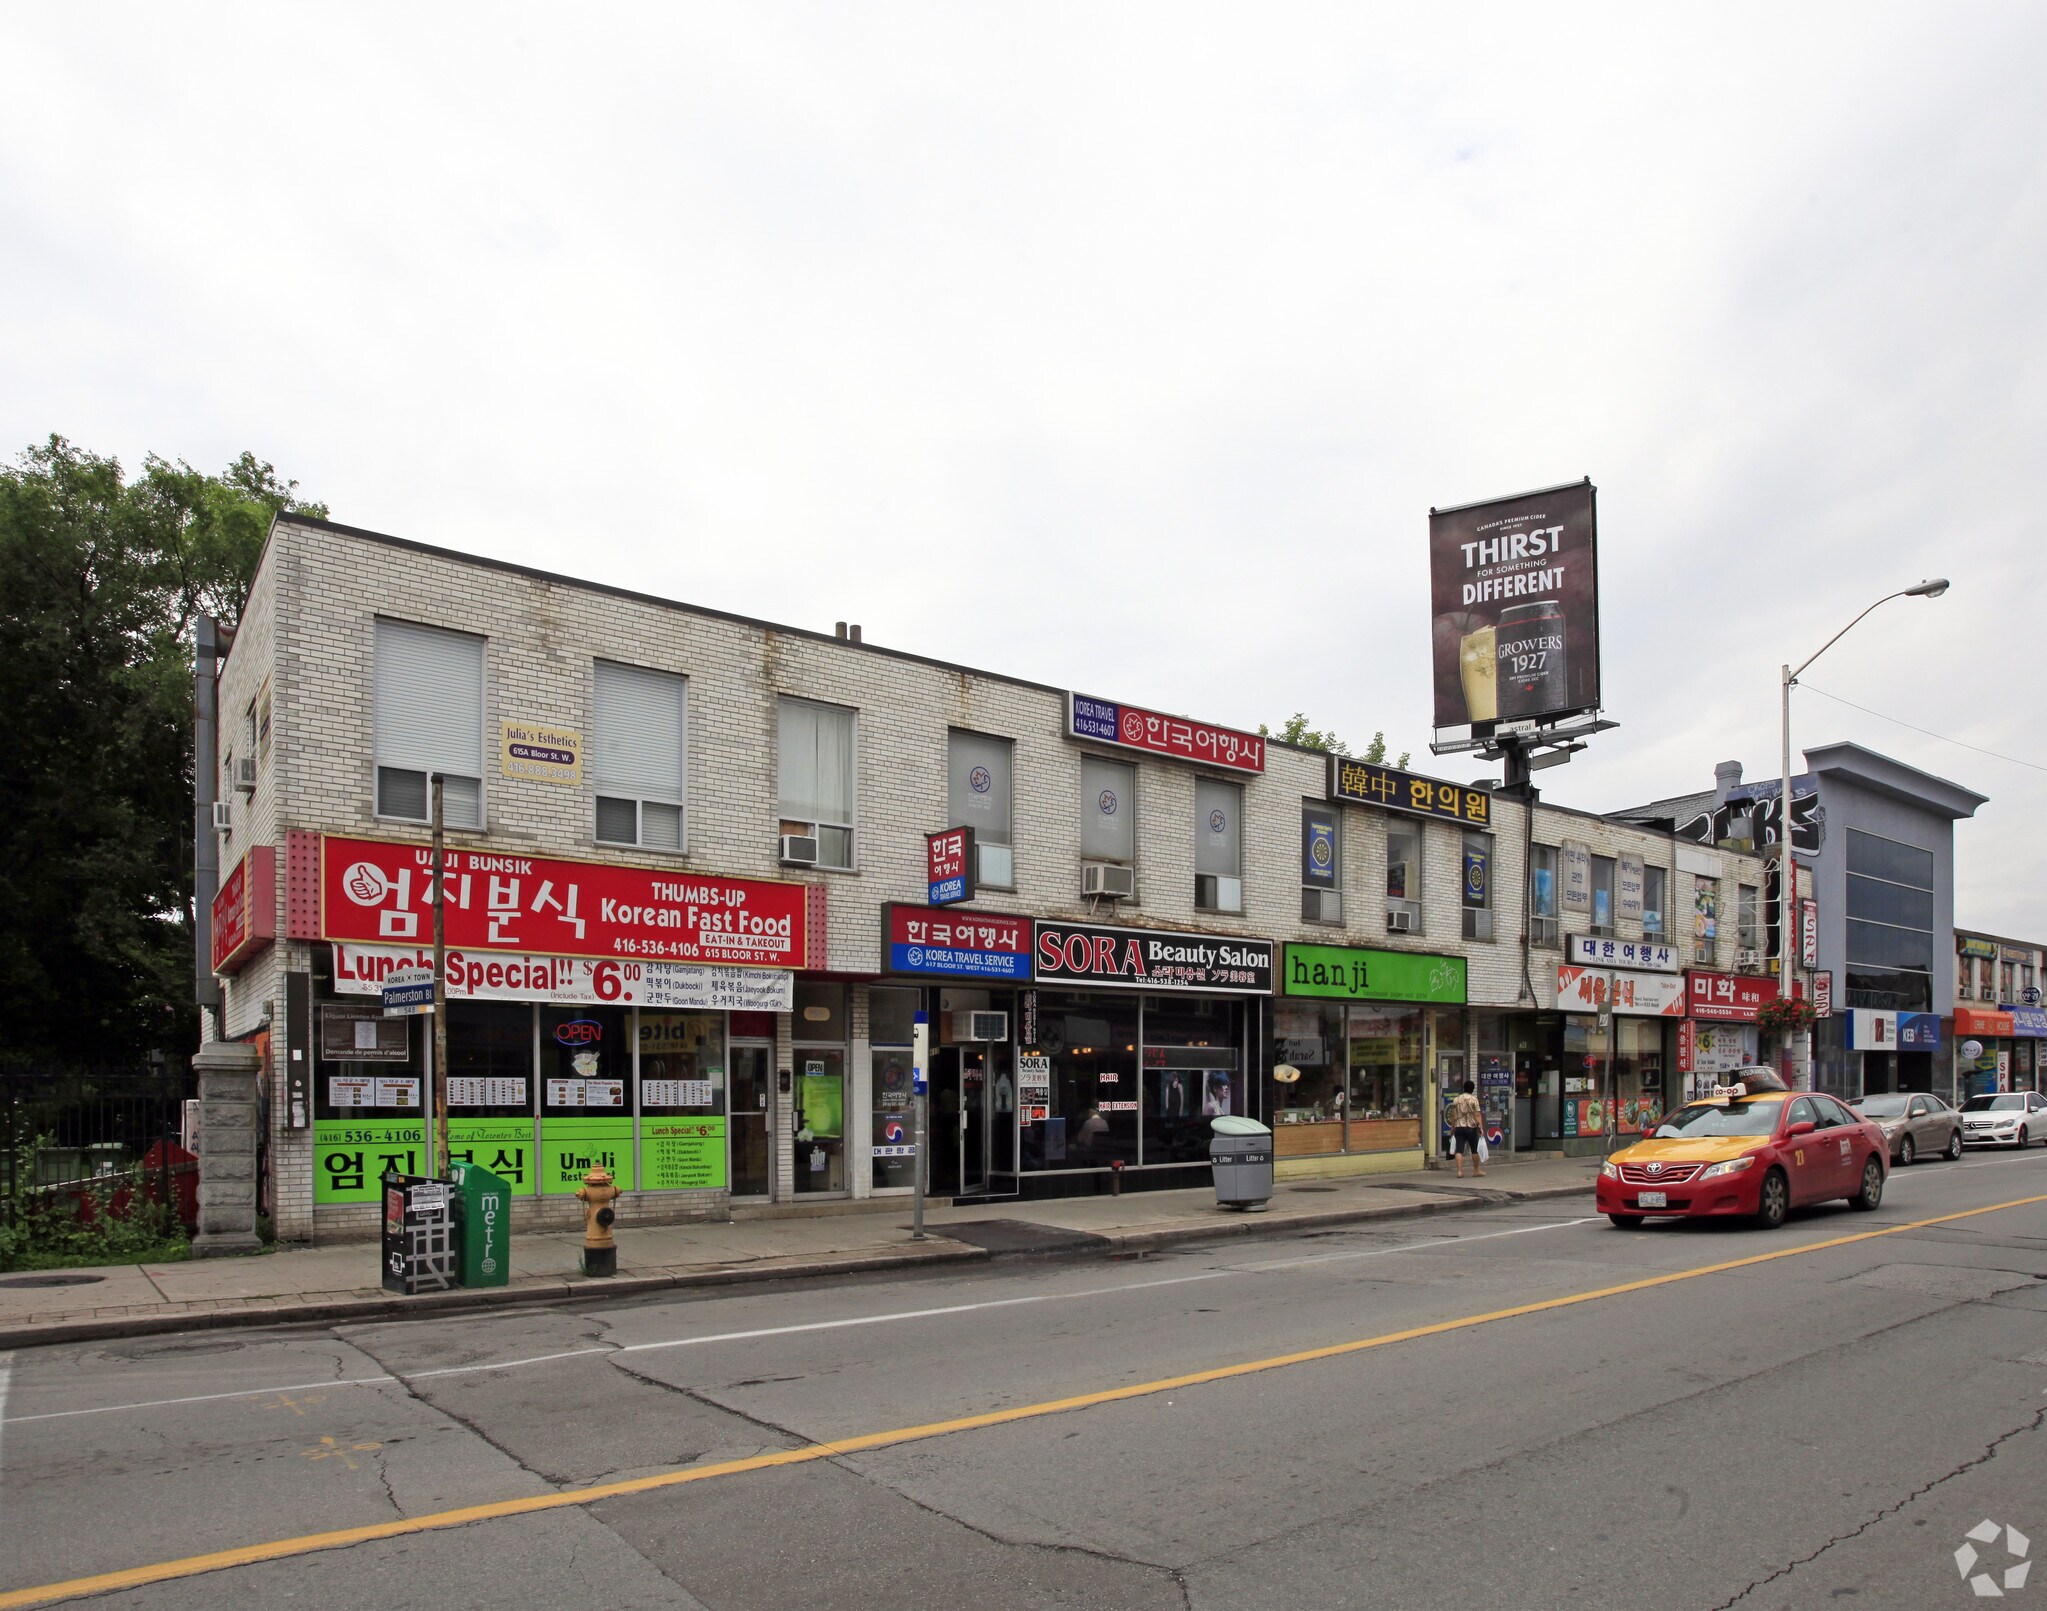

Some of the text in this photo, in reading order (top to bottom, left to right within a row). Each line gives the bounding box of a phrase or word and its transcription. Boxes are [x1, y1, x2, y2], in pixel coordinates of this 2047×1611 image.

[1504, 515, 1529, 524] PREMIUM
[1461, 525, 1564, 568] THIRST
[1477, 558, 1547, 577] FOR SOMETHING
[1463, 567, 1565, 605] DIFFERENT
[1498, 635, 1562, 659] GROWERS
[1511, 651, 1547, 673] 1927
[1075, 699, 1115, 722] KOREA TRAVEL
[1076, 717, 1115, 737] 416-531-4607
[1510, 723, 1531, 733] astral
[507, 727, 577, 748] Julia's Esthetics
[1145, 716, 1261, 767] 한국여행사
[513, 747, 571, 762] 615A Bloor St. W.
[1341, 763, 1396, 803] 韓中
[1409, 779, 1487, 823] 한의원
[932, 834, 962, 863] 한국
[469, 856, 532, 875] BUNSIK
[934, 860, 959, 876] 여행사
[651, 882, 746, 907] THUMBS-UP
[939, 880, 961, 893] KOREA
[950, 889, 961, 899] SERVICE
[601, 897, 791, 936] Korean Fast Food
[705, 934, 785, 949] EAT-IN & TAKEOUT
[907, 920, 1018, 950] 한국여행사
[1803, 918, 1816, 962] SPA
[613, 938, 699, 957] 416-536-4106
[705, 948, 780, 962] 615 BLOOR ST. W.
[1038, 931, 1147, 977] SORA
[1149, 940, 1269, 969] Beauty Salon
[1583, 940, 1669, 963] 대한 여행사
[925, 949, 1014, 967] KOREA TRAVEL SERVICE
[387, 973, 431, 984] KOREA TOWN
[446, 951, 573, 995] Special!!
[981, 965, 1014, 974] 416-531-4607
[1292, 955, 1369, 994] hanji
[384, 989, 432, 1004] Palmerston Bl
[578, 993, 595, 1001] Tax)
[646, 992, 672, 1004] 군만두
[1694, 977, 1736, 1003] 미화
[1815, 992, 1829, 1017] SPA
[557, 1023, 601, 1041] OPEN
[1902, 1028, 1914, 1042] KEB
[807, 1062, 823, 1072] OPEN
[1019, 1058, 1048, 1069] SORA
[1100, 1073, 1118, 1082] HAIR
[1715, 1088, 1738, 1096] co-op
[1112, 1101, 1138, 1110] EXTENSION
[319, 1133, 342, 1143] (416)
[448, 1130, 464, 1139] ome
[466, 1130, 475, 1141] of
[514, 1128, 532, 1139] Best
[652, 1126, 670, 1135] Lunch
[324, 1148, 524, 1190] 엄지식
[560, 1152, 591, 1169] Um
[561, 1170, 616, 1182] Restt
